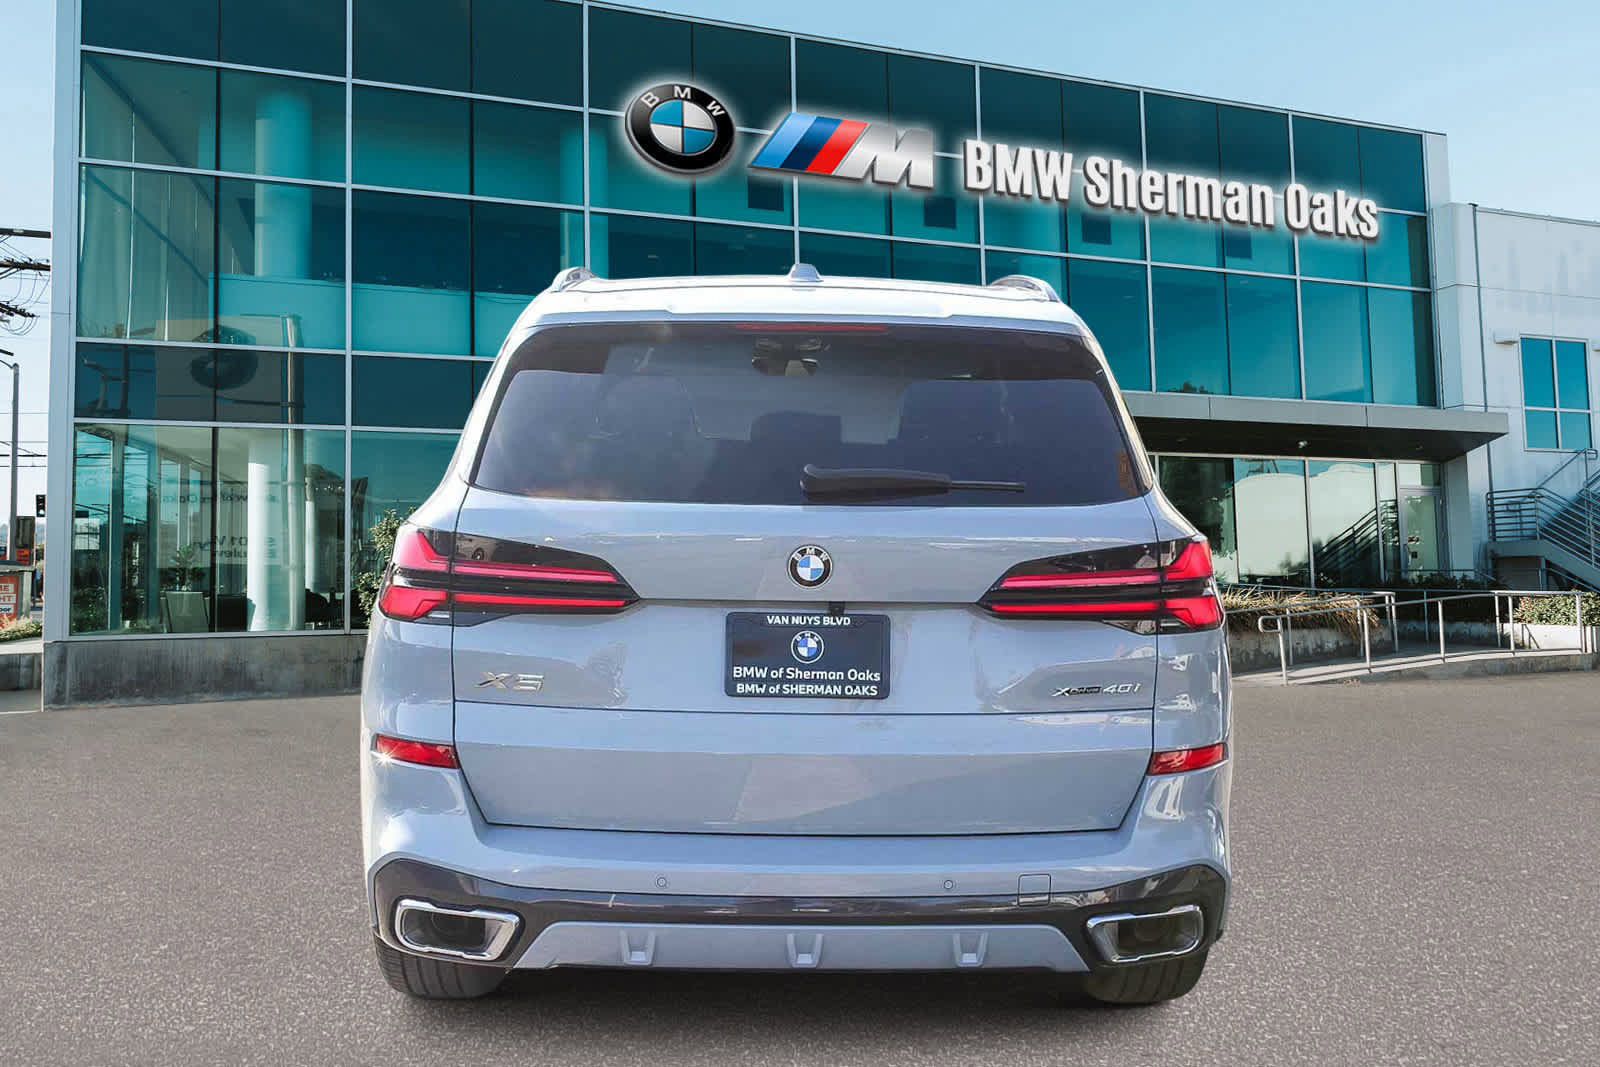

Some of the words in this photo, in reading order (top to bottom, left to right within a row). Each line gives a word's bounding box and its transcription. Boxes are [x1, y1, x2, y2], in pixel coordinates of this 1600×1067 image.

[640, 85, 725, 117] BMW
[963, 138, 1073, 200] BMW
[1083, 156, 1275, 226] Sherman
[1284, 182, 1380, 240] Oaks
[794, 547, 828, 561] BMW
[767, 615, 790, 625] VAN
[791, 616, 820, 626] NUYS
[822, 617, 850, 626] BLVD
[733, 666, 767, 678] BMW
[770, 667, 784, 679] of
[786, 668, 844, 680] Sherman
[847, 669, 881, 681] Oaks
[473, 672, 544, 692] X5
[736, 684, 766, 694] BMW
[768, 684, 781, 693] of
[783, 685, 842, 695] SHERMAN
[844, 686, 878, 696] OAKS
